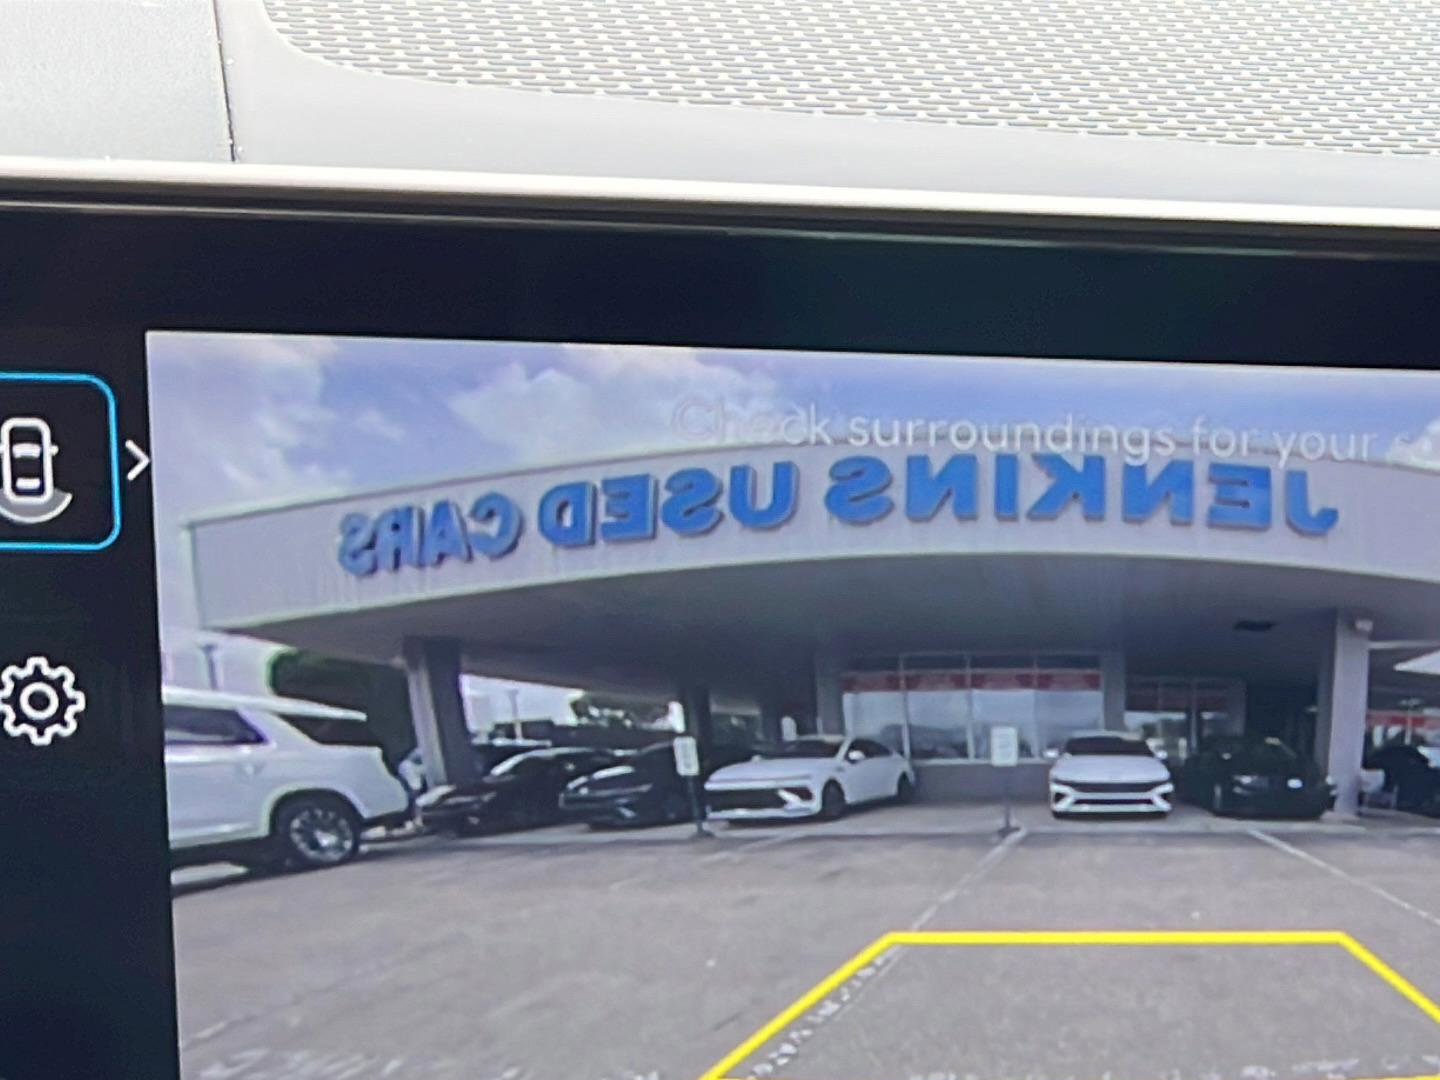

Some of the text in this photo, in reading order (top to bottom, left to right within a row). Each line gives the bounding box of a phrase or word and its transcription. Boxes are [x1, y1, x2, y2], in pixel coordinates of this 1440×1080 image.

[848, 412, 1176, 466] surroundings
[1191, 415, 1261, 457] for
[1275, 428, 1379, 469] your
